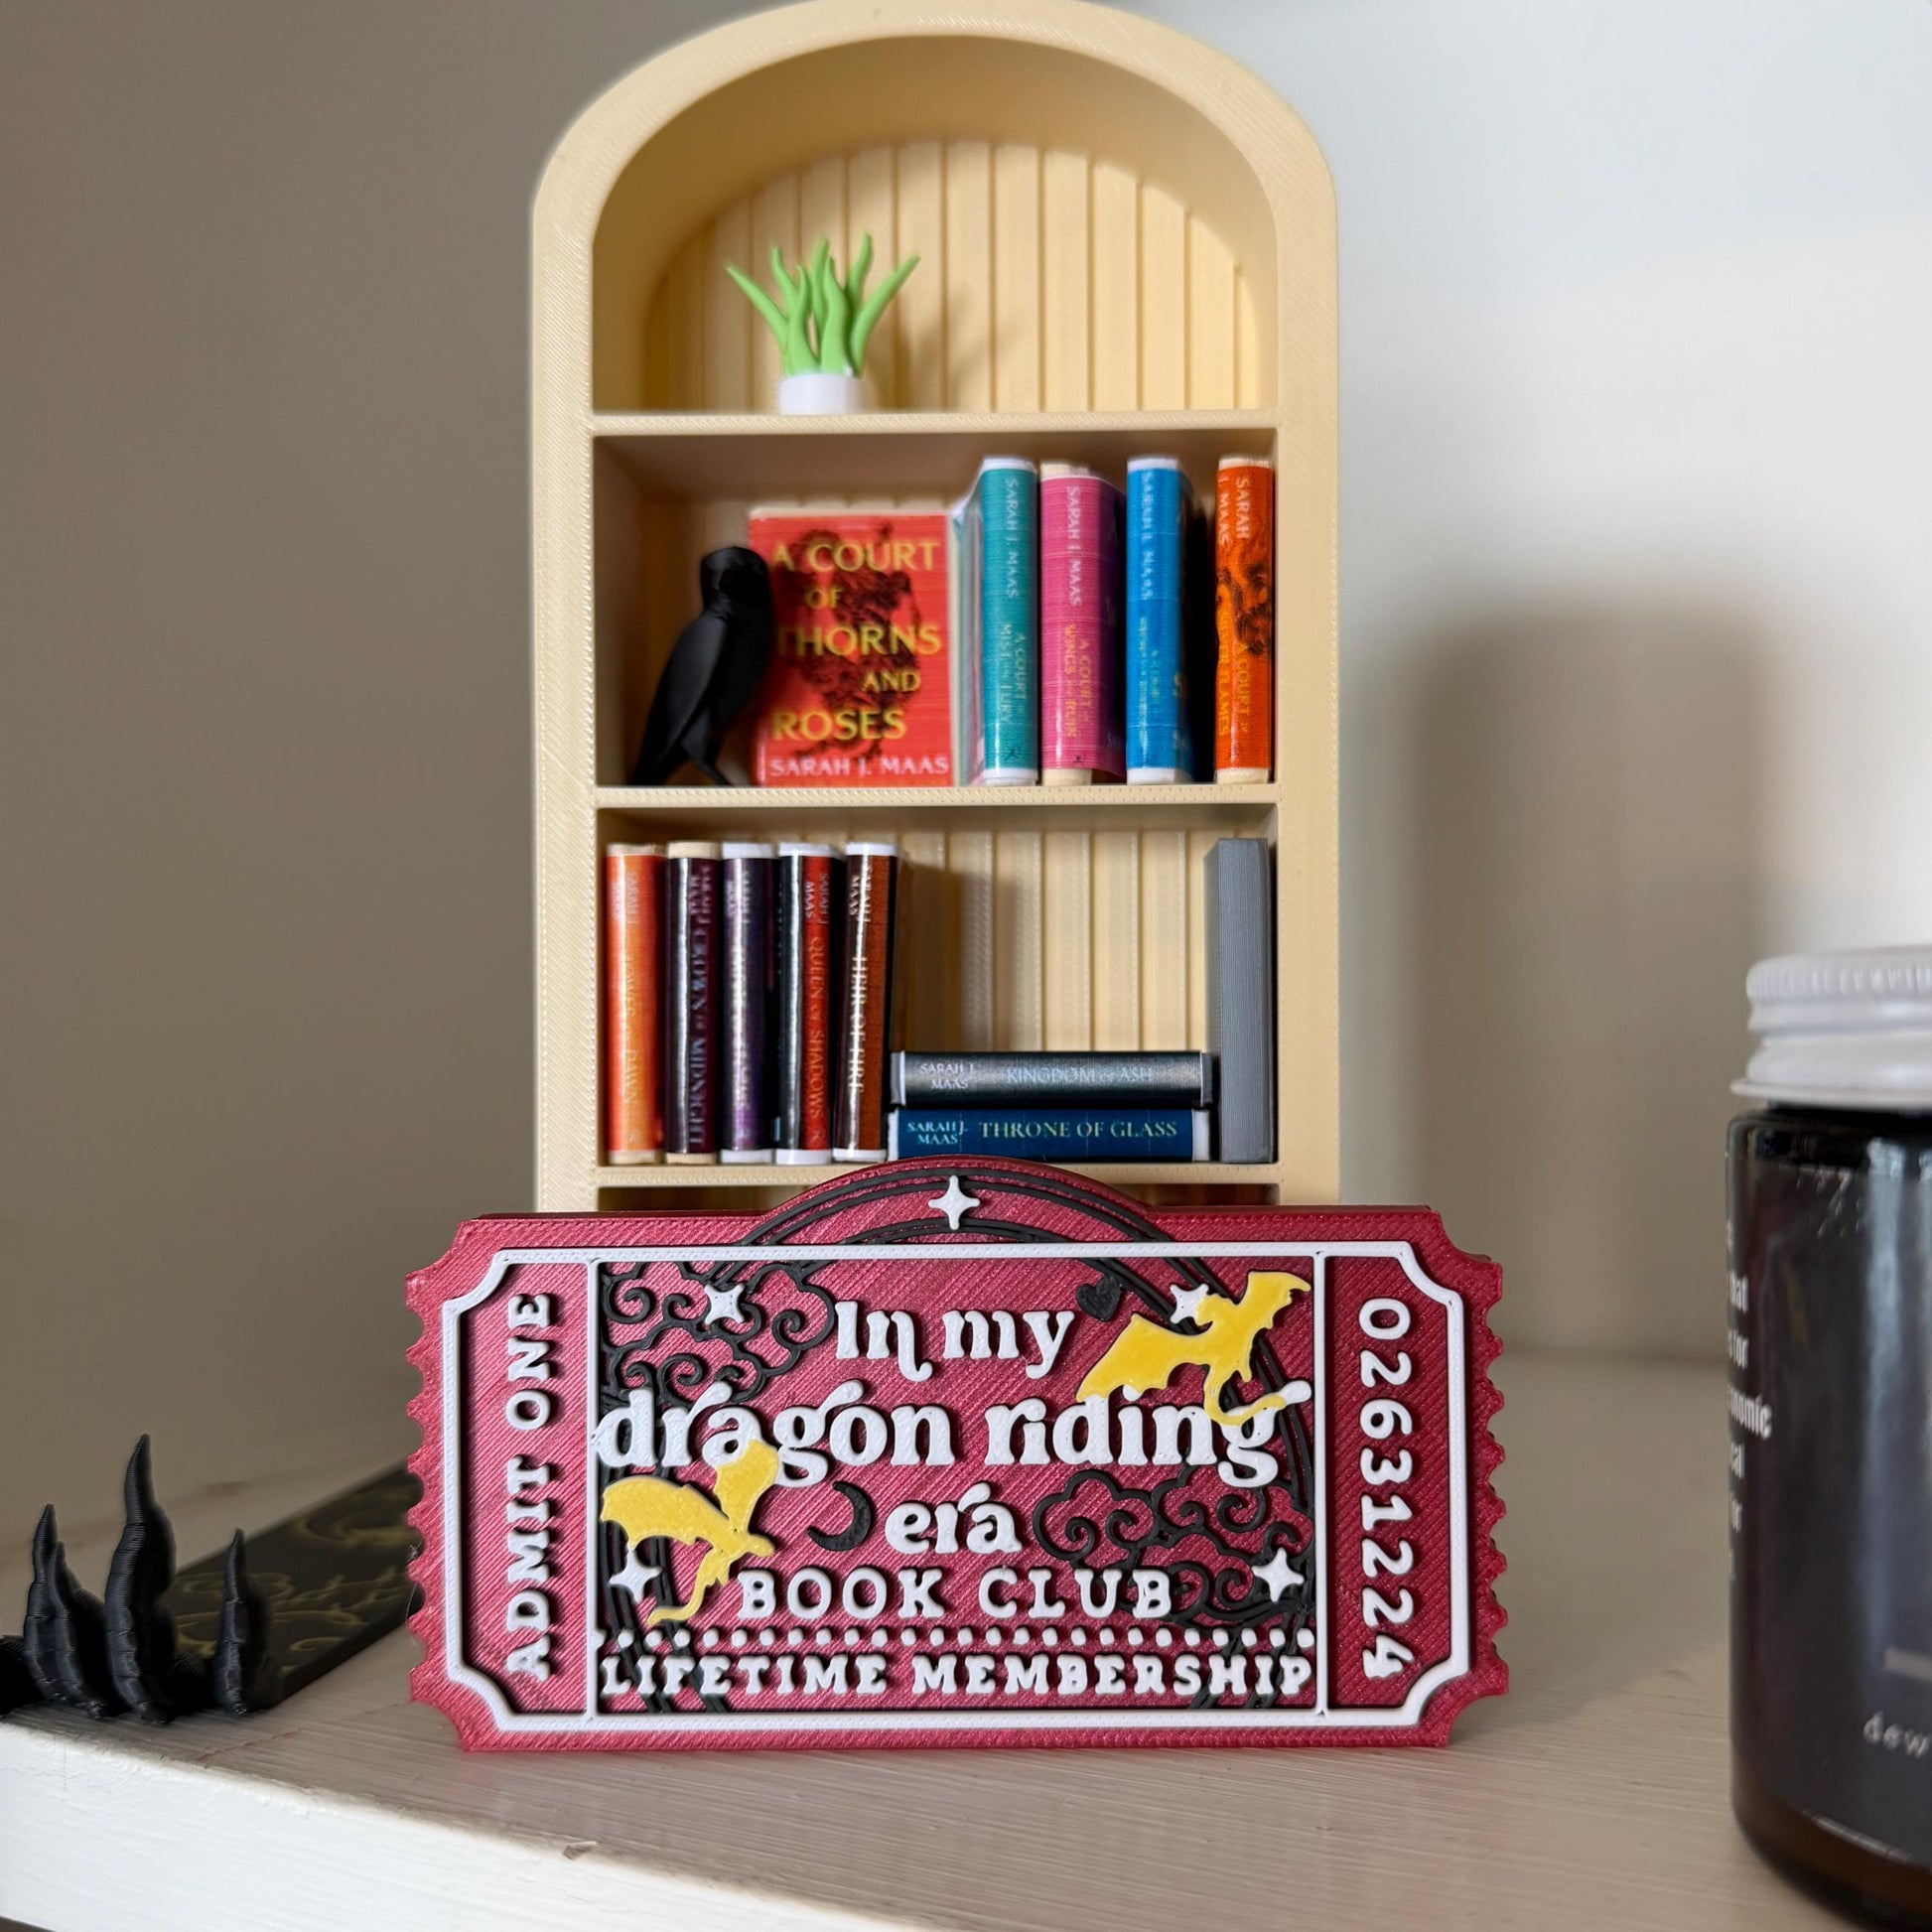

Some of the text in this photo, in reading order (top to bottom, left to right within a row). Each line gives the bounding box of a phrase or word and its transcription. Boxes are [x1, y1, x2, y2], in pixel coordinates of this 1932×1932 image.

[1004, 478, 1019, 531] SARAH
[1066, 485, 1081, 539] SARAH
[1218, 492, 1230, 545] MAAS
[1236, 477, 1250, 539] SARAH
[772, 540, 941, 572] A COURT
[1006, 550, 1020, 599] MAAS
[803, 587, 842, 609] OF
[1069, 559, 1082, 607] MAAS
[778, 624, 942, 655] THORNS
[1064, 623, 1077, 675] WINGS
[861, 670, 921, 692] AND
[1015, 647, 1027, 699] COURT
[1079, 655, 1092, 708] COURT
[1236, 662, 1249, 716] COURT
[769, 709, 907, 742] ROSES
[1066, 700, 1078, 738] RUIN
[769, 759, 850, 777] SARAH
[880, 757, 949, 775] MAAS
[804, 881, 815, 919] MAAS
[848, 874, 860, 916] MAAS
[690, 929, 708, 1011] CROWN
[808, 936, 824, 1006] QUEEN
[848, 956, 869, 1093] HEIR OF FIRE
[689, 1036, 708, 1146] MIDNIGHT
[808, 1030, 824, 1119] SHADOWS
[920, 1063, 964, 1073] SARAH
[931, 1079, 969, 1089] MAAS
[1007, 1067, 1095, 1084] KINGDOM
[1120, 1067, 1153, 1082] ASH
[907, 1121, 956, 1133] SARAH
[917, 1134, 958, 1145] MAAS
[979, 1121, 1177, 1139] THRONE OF GLASS
[835, 1301, 1075, 1382] In my
[596, 1380, 1311, 1488] dragon riding
[506, 1293, 550, 1681] ADMIT ONE
[1358, 1297, 1414, 1679] 02631224
[886, 1482, 1023, 1555] era
[738, 1567, 1173, 1621] BOOK CLUB
[601, 1654, 1311, 1697] LIFETIME MEMBERSHIP
